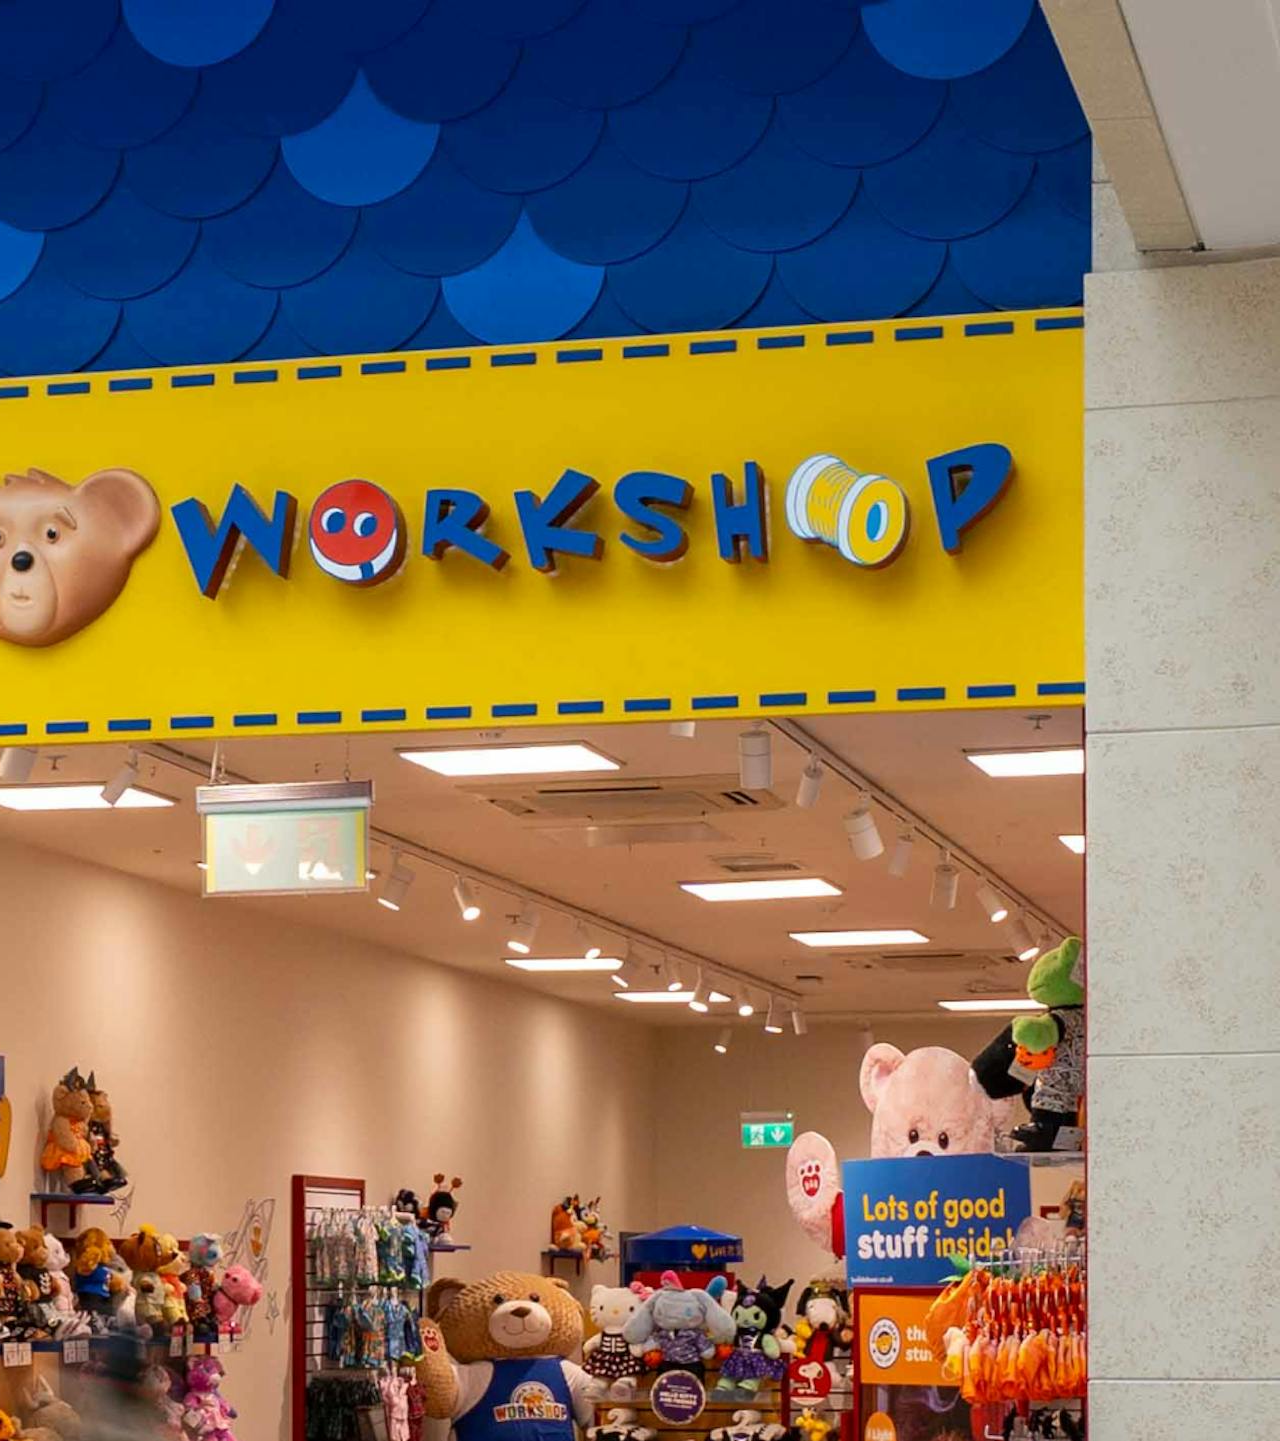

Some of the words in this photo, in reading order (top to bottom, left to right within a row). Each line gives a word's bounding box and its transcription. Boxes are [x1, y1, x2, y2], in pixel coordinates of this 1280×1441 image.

[862, 1193, 910, 1221] Lots
[914, 1190, 939, 1220] of
[943, 1187, 1006, 1228] good
[857, 1225, 929, 1259] stuff
